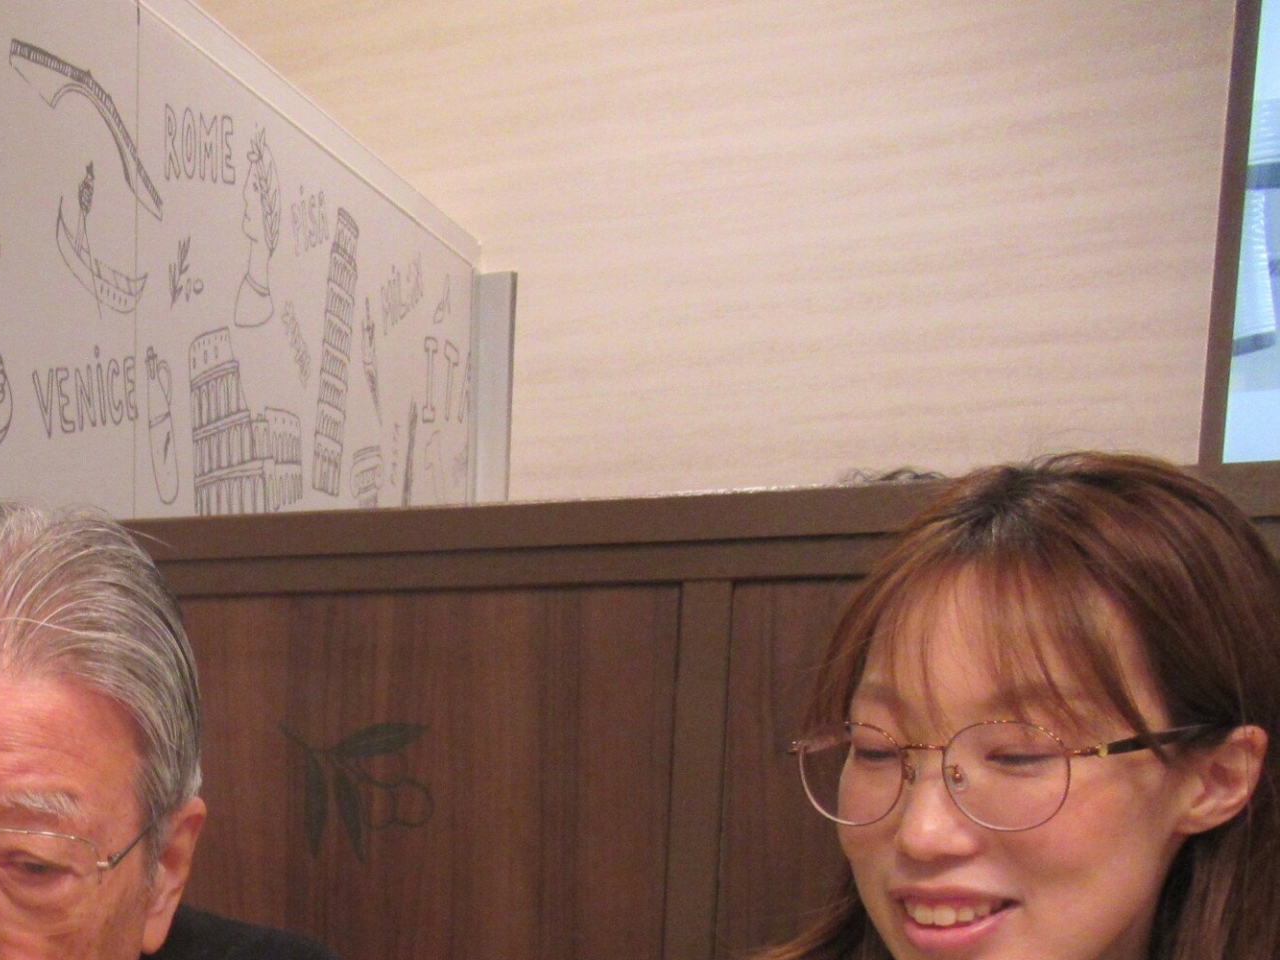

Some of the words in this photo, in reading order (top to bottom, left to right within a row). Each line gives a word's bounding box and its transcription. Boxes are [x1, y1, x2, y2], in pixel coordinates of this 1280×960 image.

[164, 103, 236, 185] ROME
[291, 185, 329, 258] PISA
[31, 345, 139, 440] VENICE
